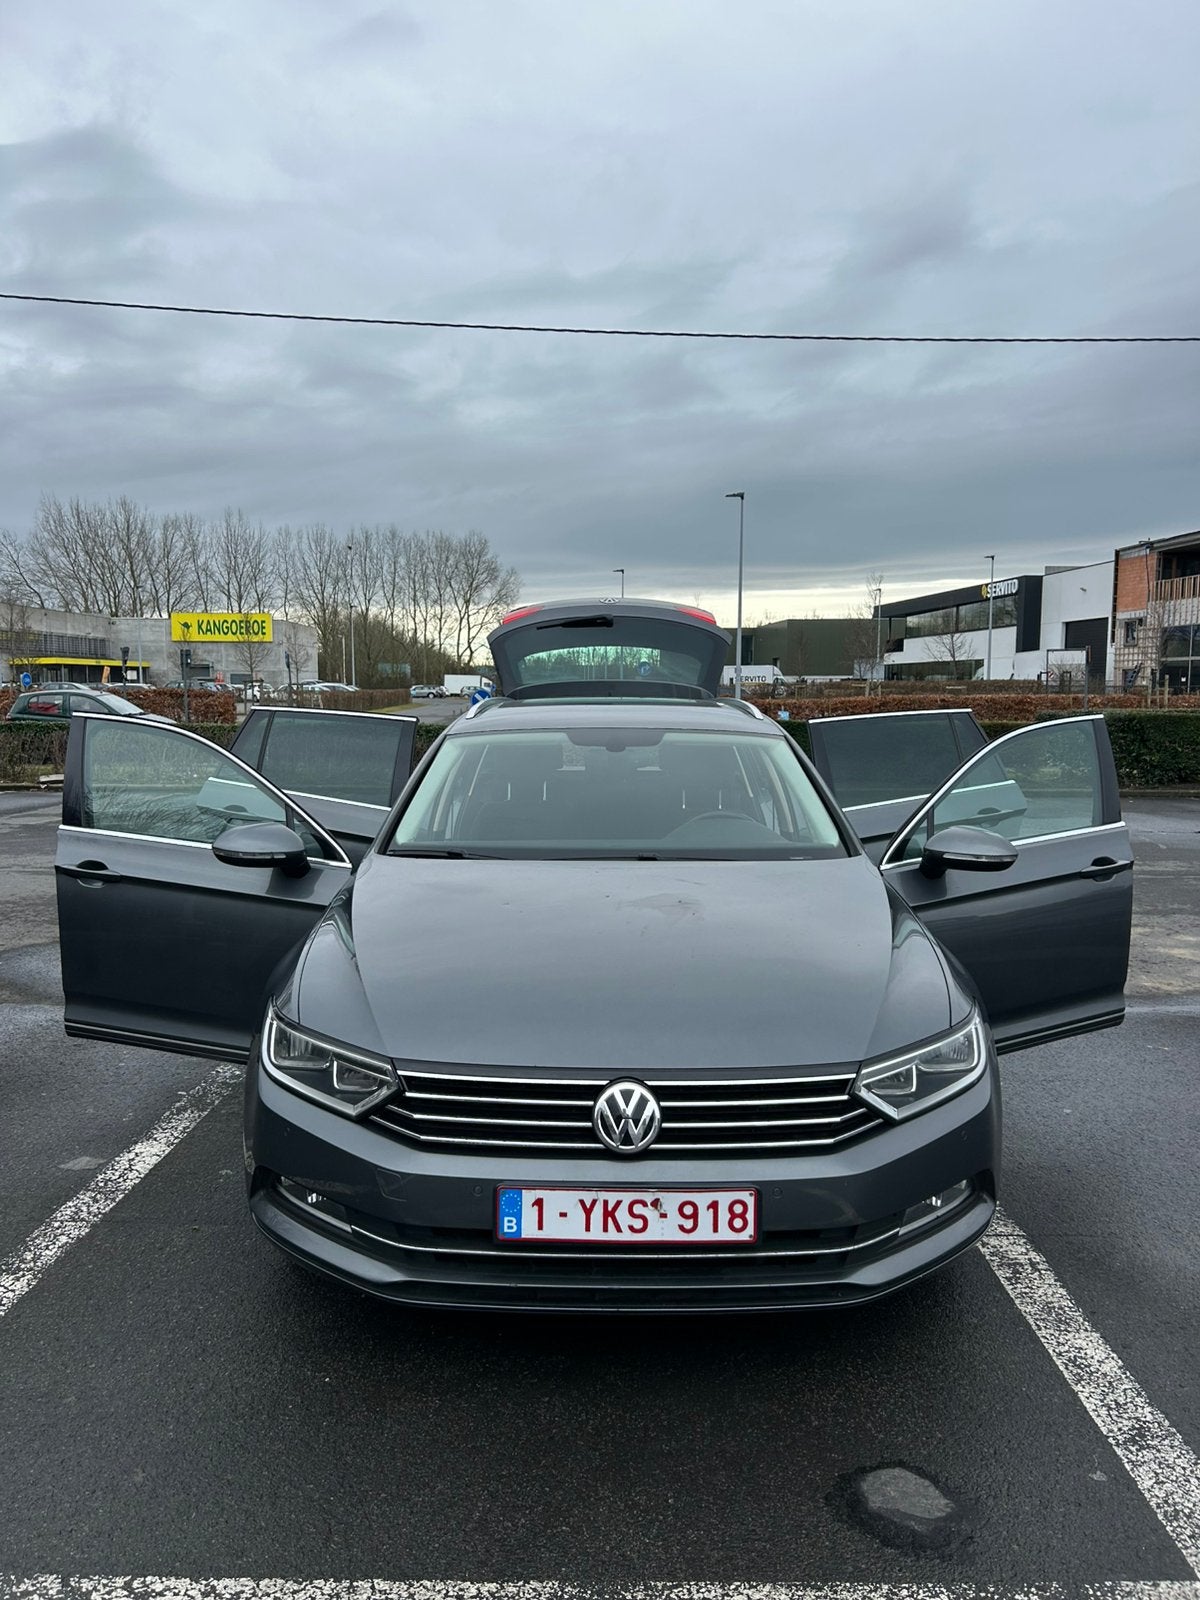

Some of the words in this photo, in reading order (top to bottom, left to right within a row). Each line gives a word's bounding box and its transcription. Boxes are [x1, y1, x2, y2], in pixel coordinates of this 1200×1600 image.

[986, 578, 1019, 598] SERVITO
[197, 619, 267, 636] KANGOEROE
[735, 674, 767, 683] ERVITO
[503, 1216, 518, 1234] B
